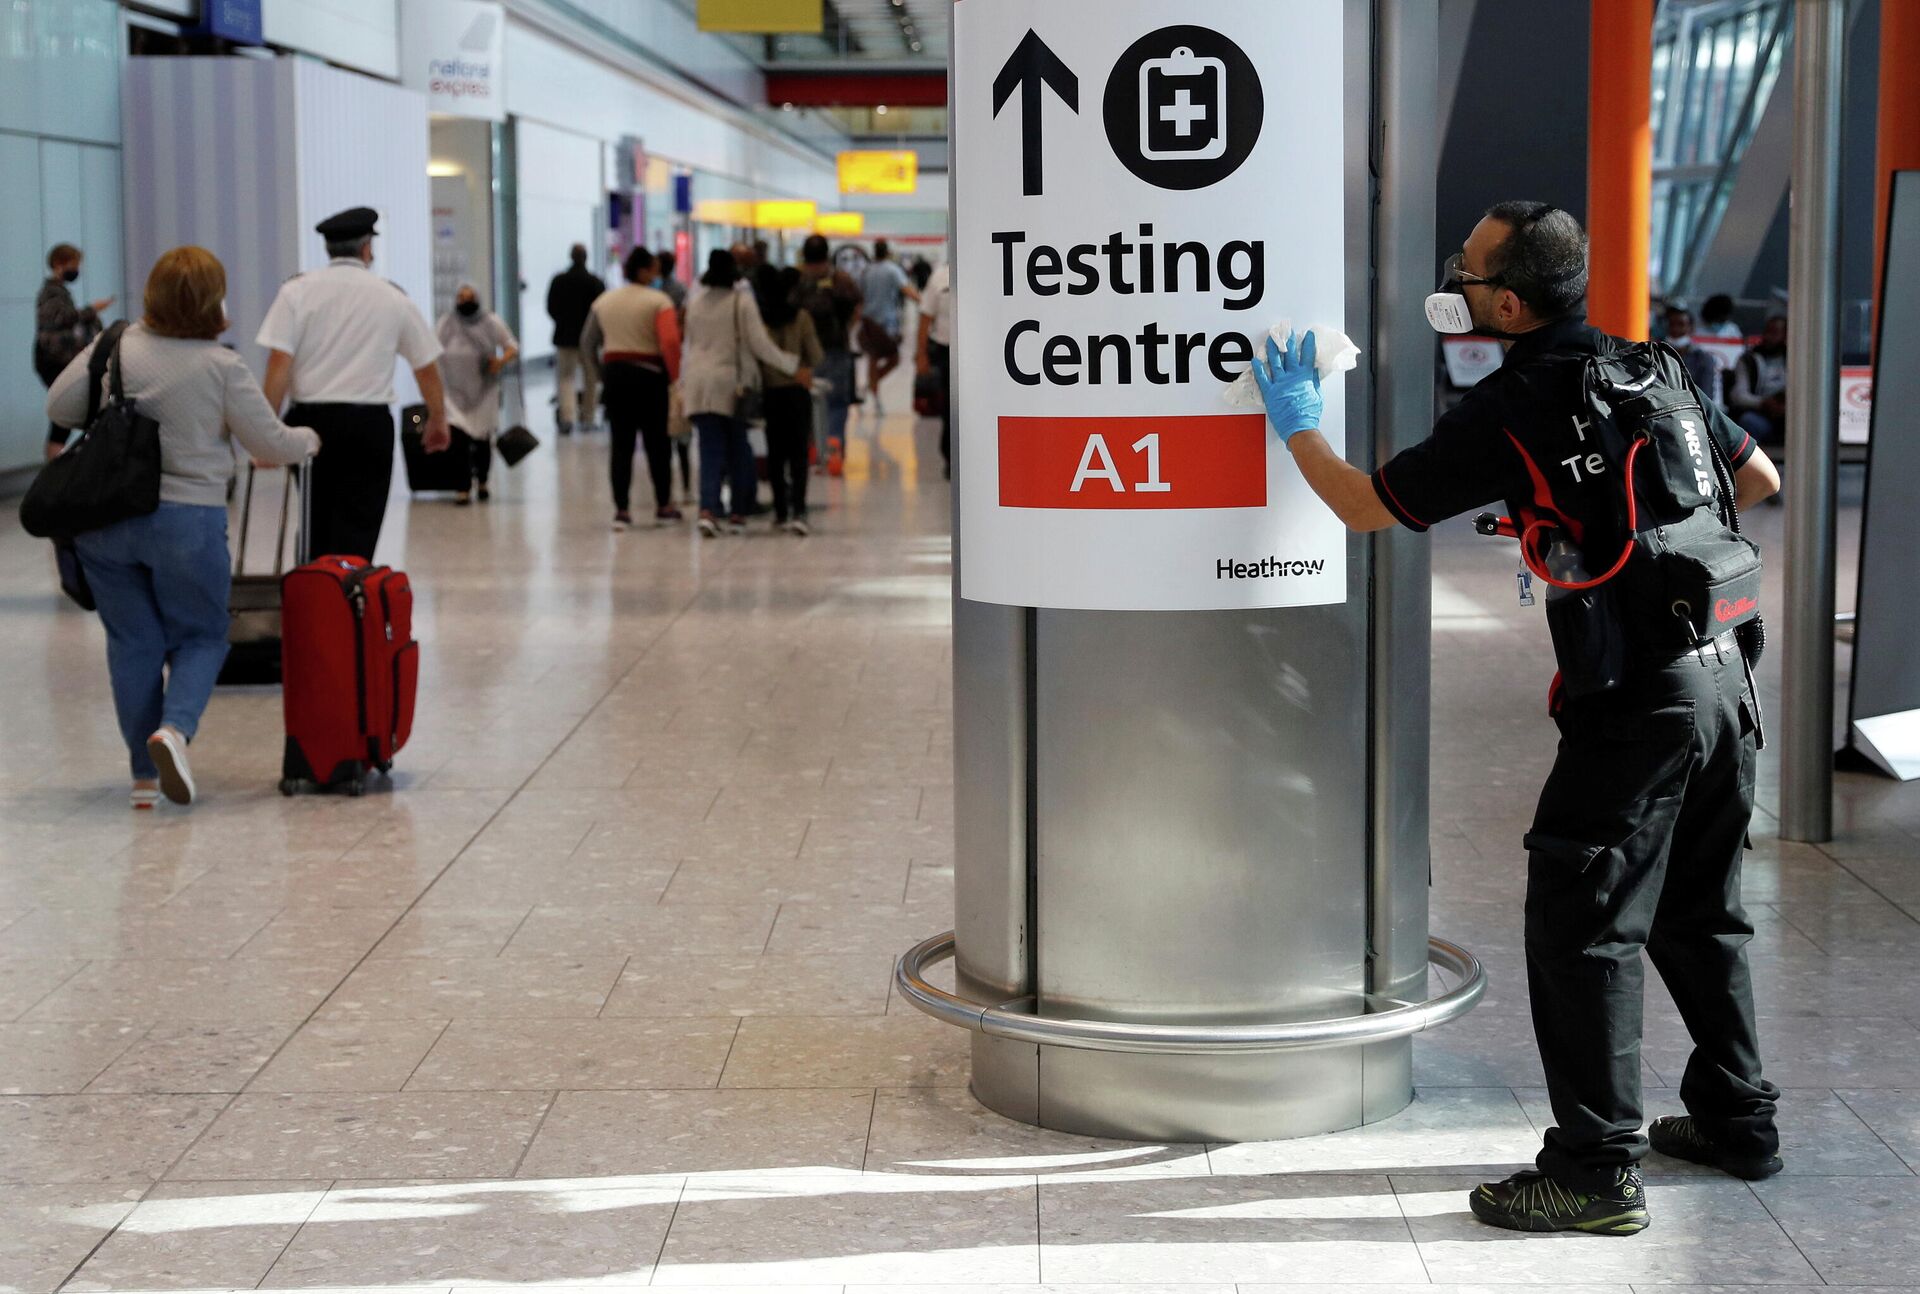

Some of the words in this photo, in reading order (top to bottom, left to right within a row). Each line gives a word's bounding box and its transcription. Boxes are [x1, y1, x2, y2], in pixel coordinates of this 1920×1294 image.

[991, 223, 1265, 311] Testing
[1003, 320, 1255, 386] Centre
[1571, 414, 1592, 441] H
[1070, 433, 1171, 493] A1
[1561, 453, 1606, 483] Te
[1216, 556, 1325, 580] Heathrow
